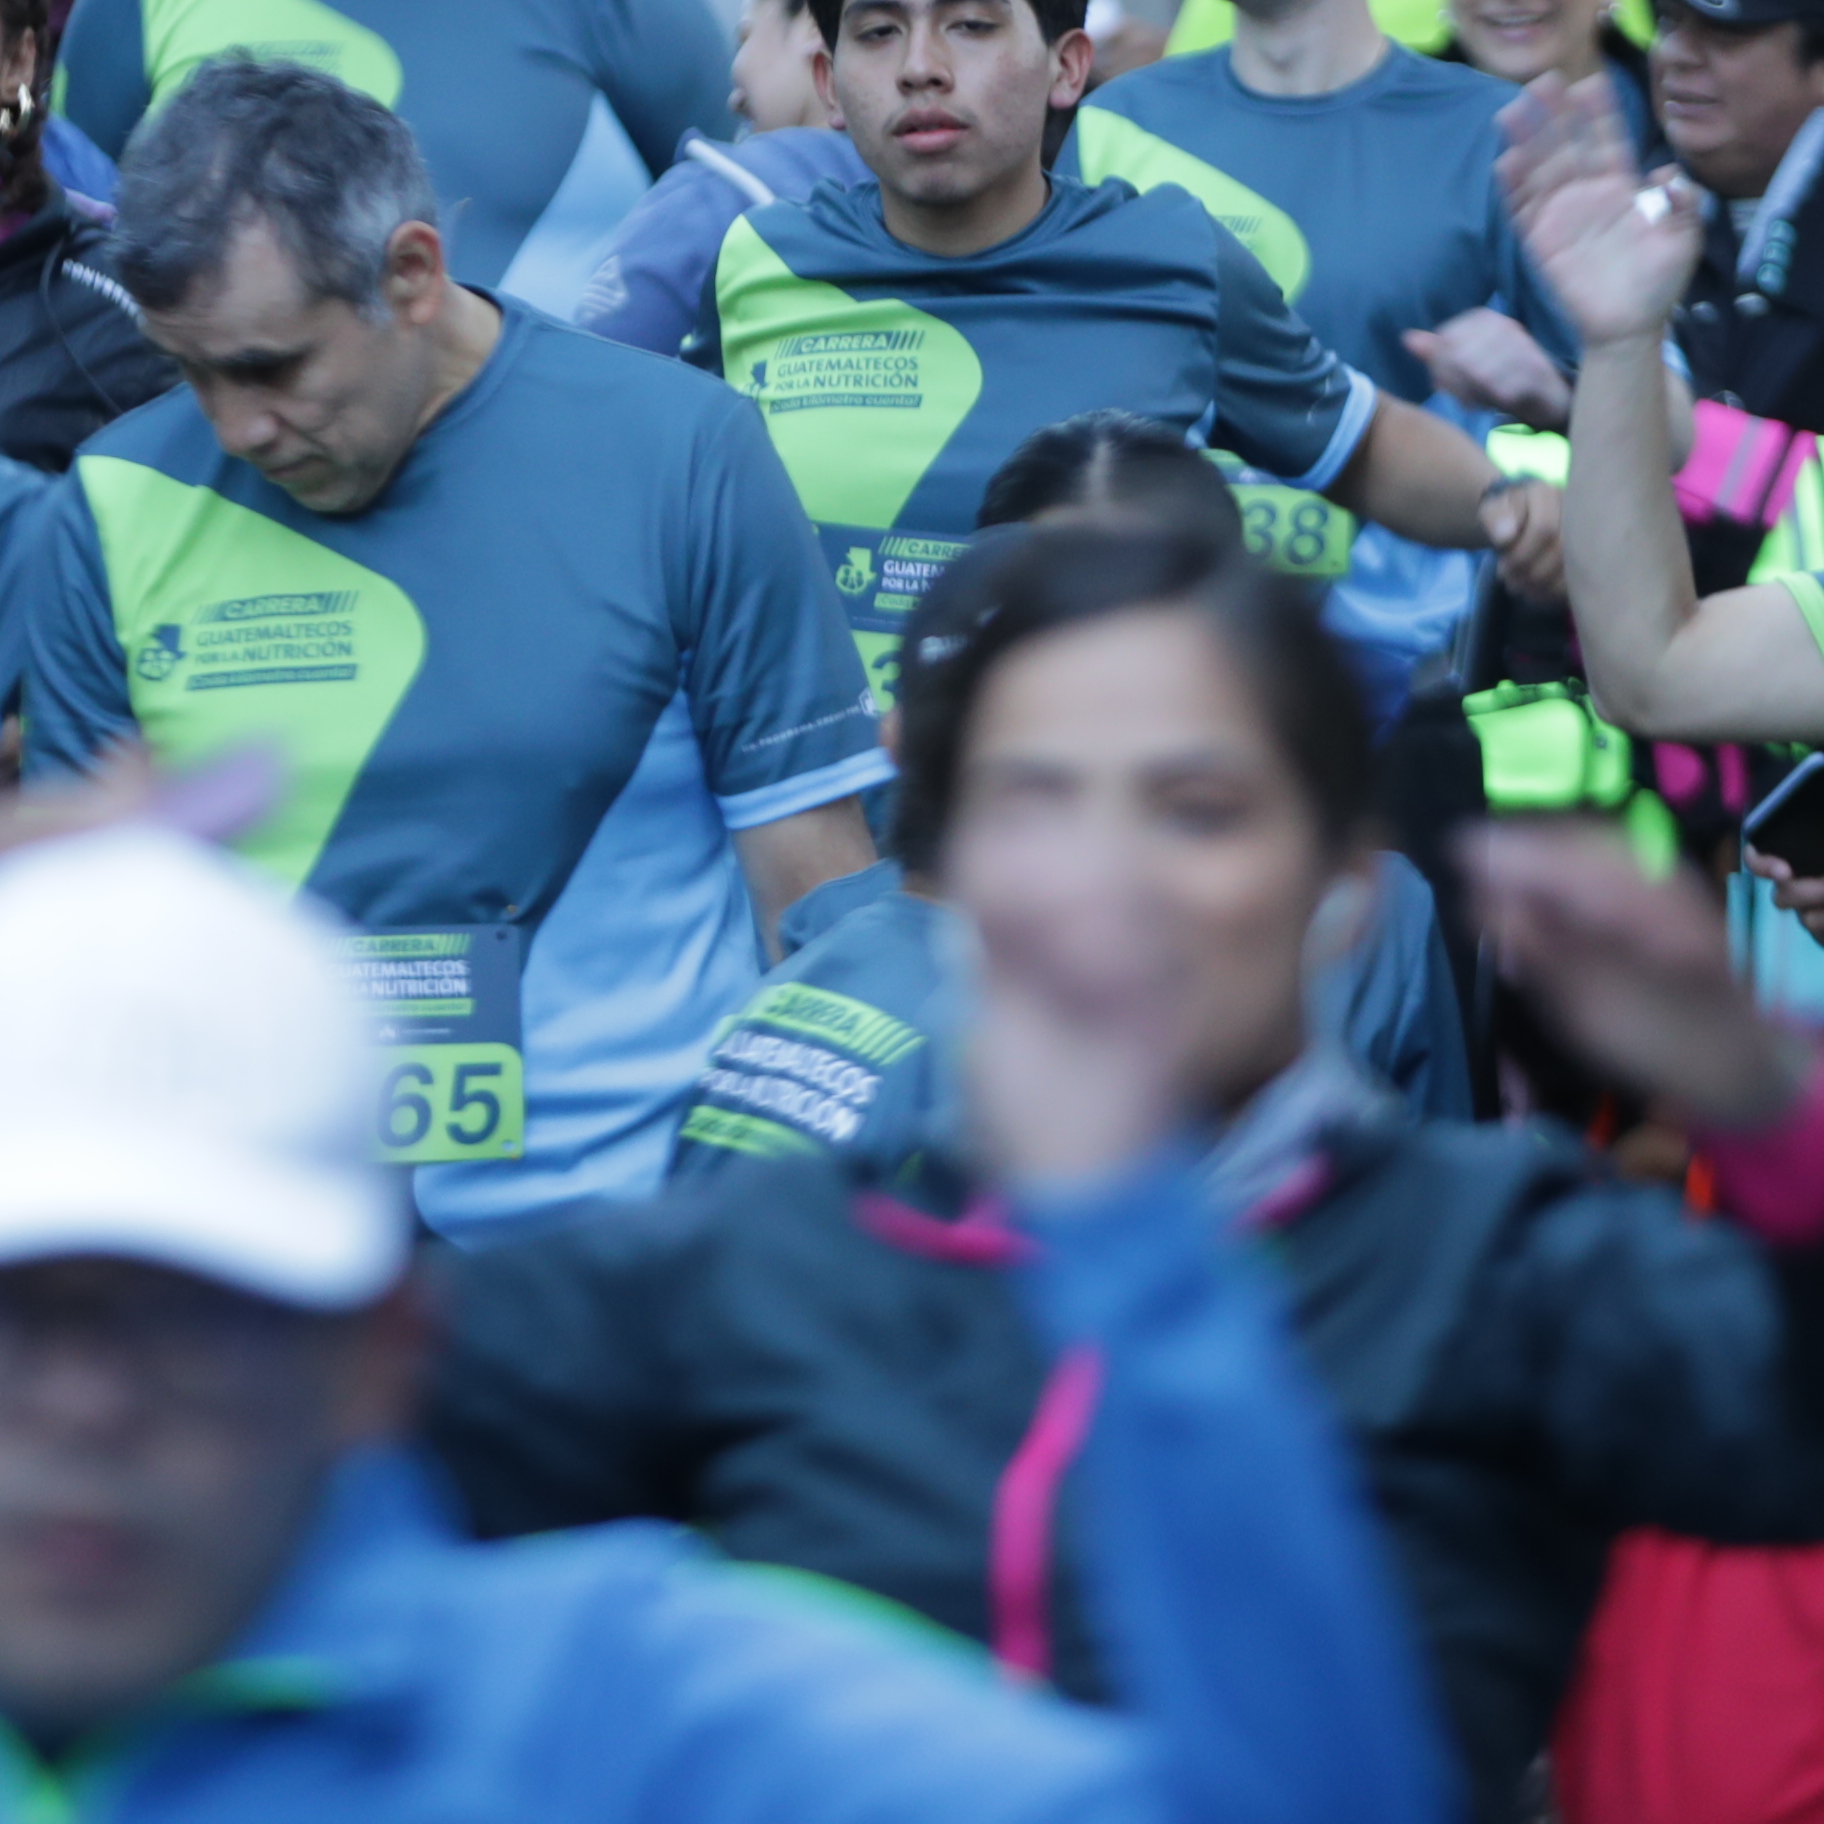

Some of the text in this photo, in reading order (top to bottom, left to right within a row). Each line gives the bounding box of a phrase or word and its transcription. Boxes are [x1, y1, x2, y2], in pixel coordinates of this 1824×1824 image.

[801, 333, 888, 353] CARRERA
[777, 356, 918, 378] GUATEMALTECOS
[776, 371, 919, 391] POR LA NUTRICIÓN
[882, 577, 904, 590] POR
[905, 578, 918, 591] LA
[226, 596, 321, 619] CARRERA
[196, 620, 353, 647] GUATEMALTECOS
[242, 640, 353, 662] NUTRICIÓN
